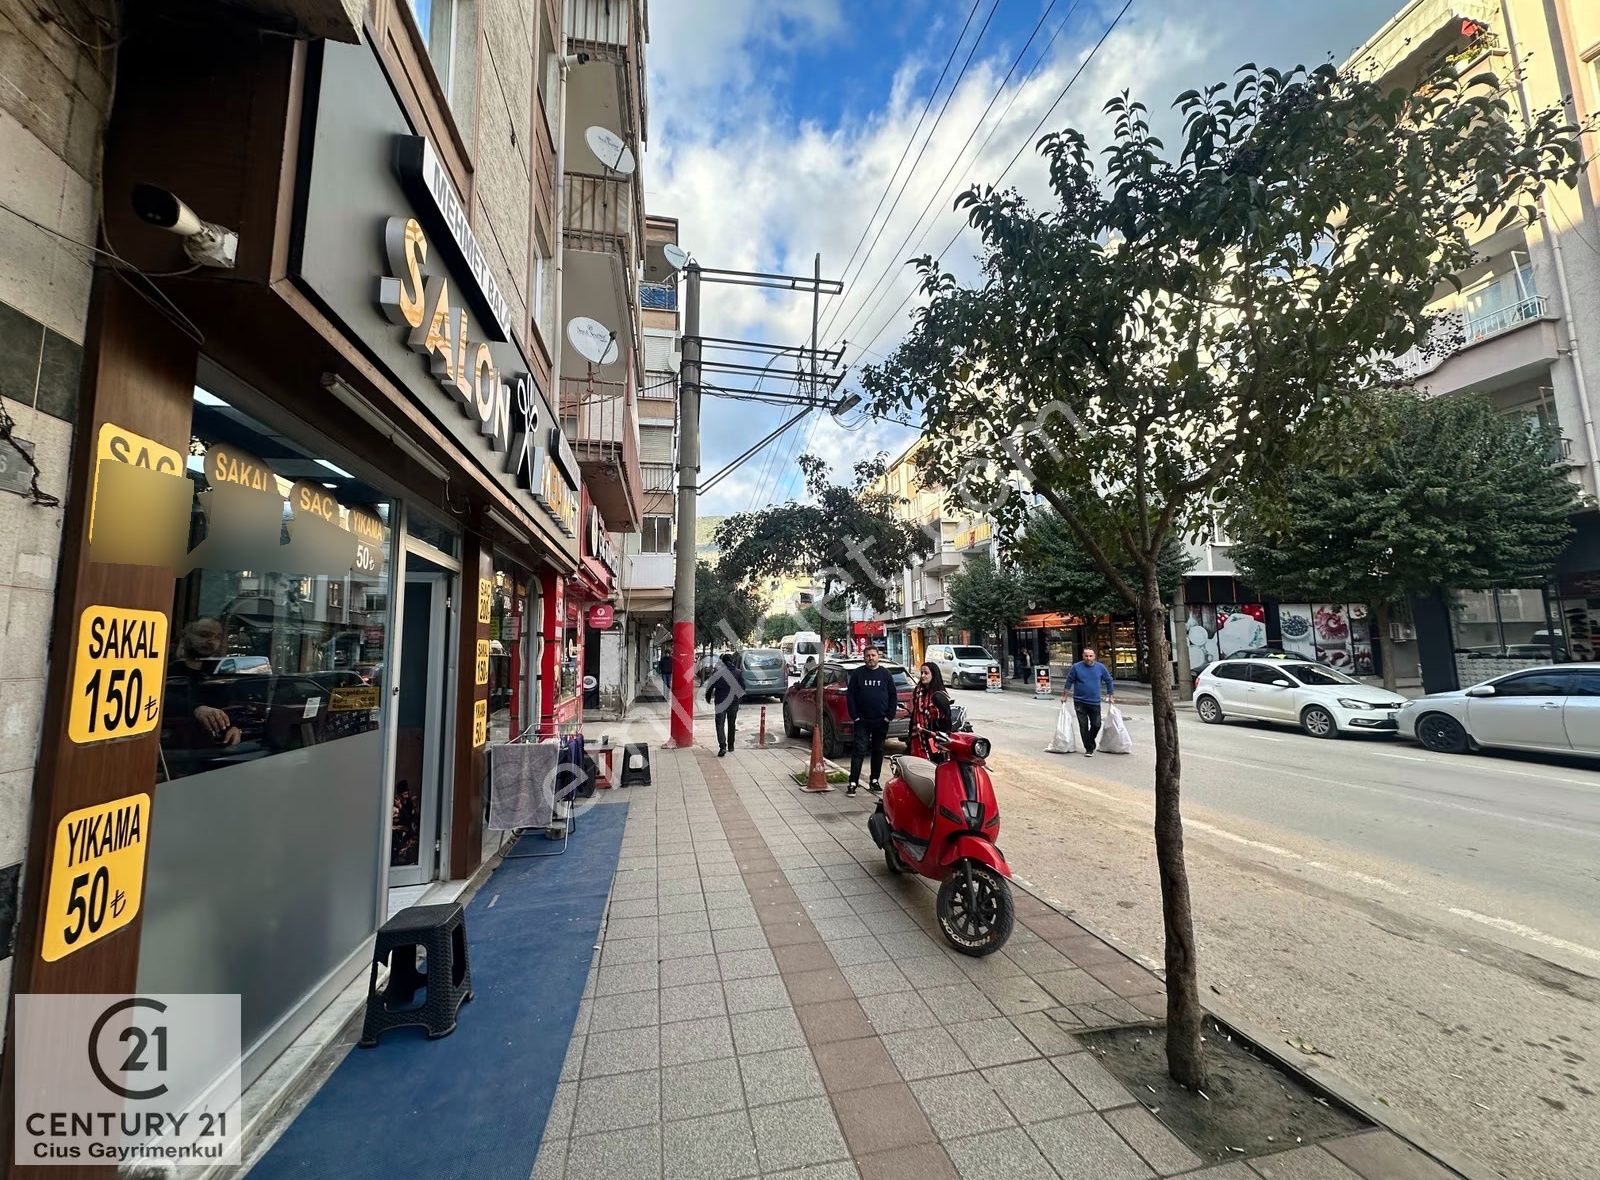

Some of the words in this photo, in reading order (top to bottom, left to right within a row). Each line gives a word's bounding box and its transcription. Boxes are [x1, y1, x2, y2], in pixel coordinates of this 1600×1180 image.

[433, 162, 487, 287] MEHMET
[400, 218, 511, 452] SALON
[300, 487, 333, 522] SAÇ
[353, 509, 384, 542] YIKAMA
[89, 616, 159, 659] SAKAL
[67, 803, 141, 868] YIKAMA
